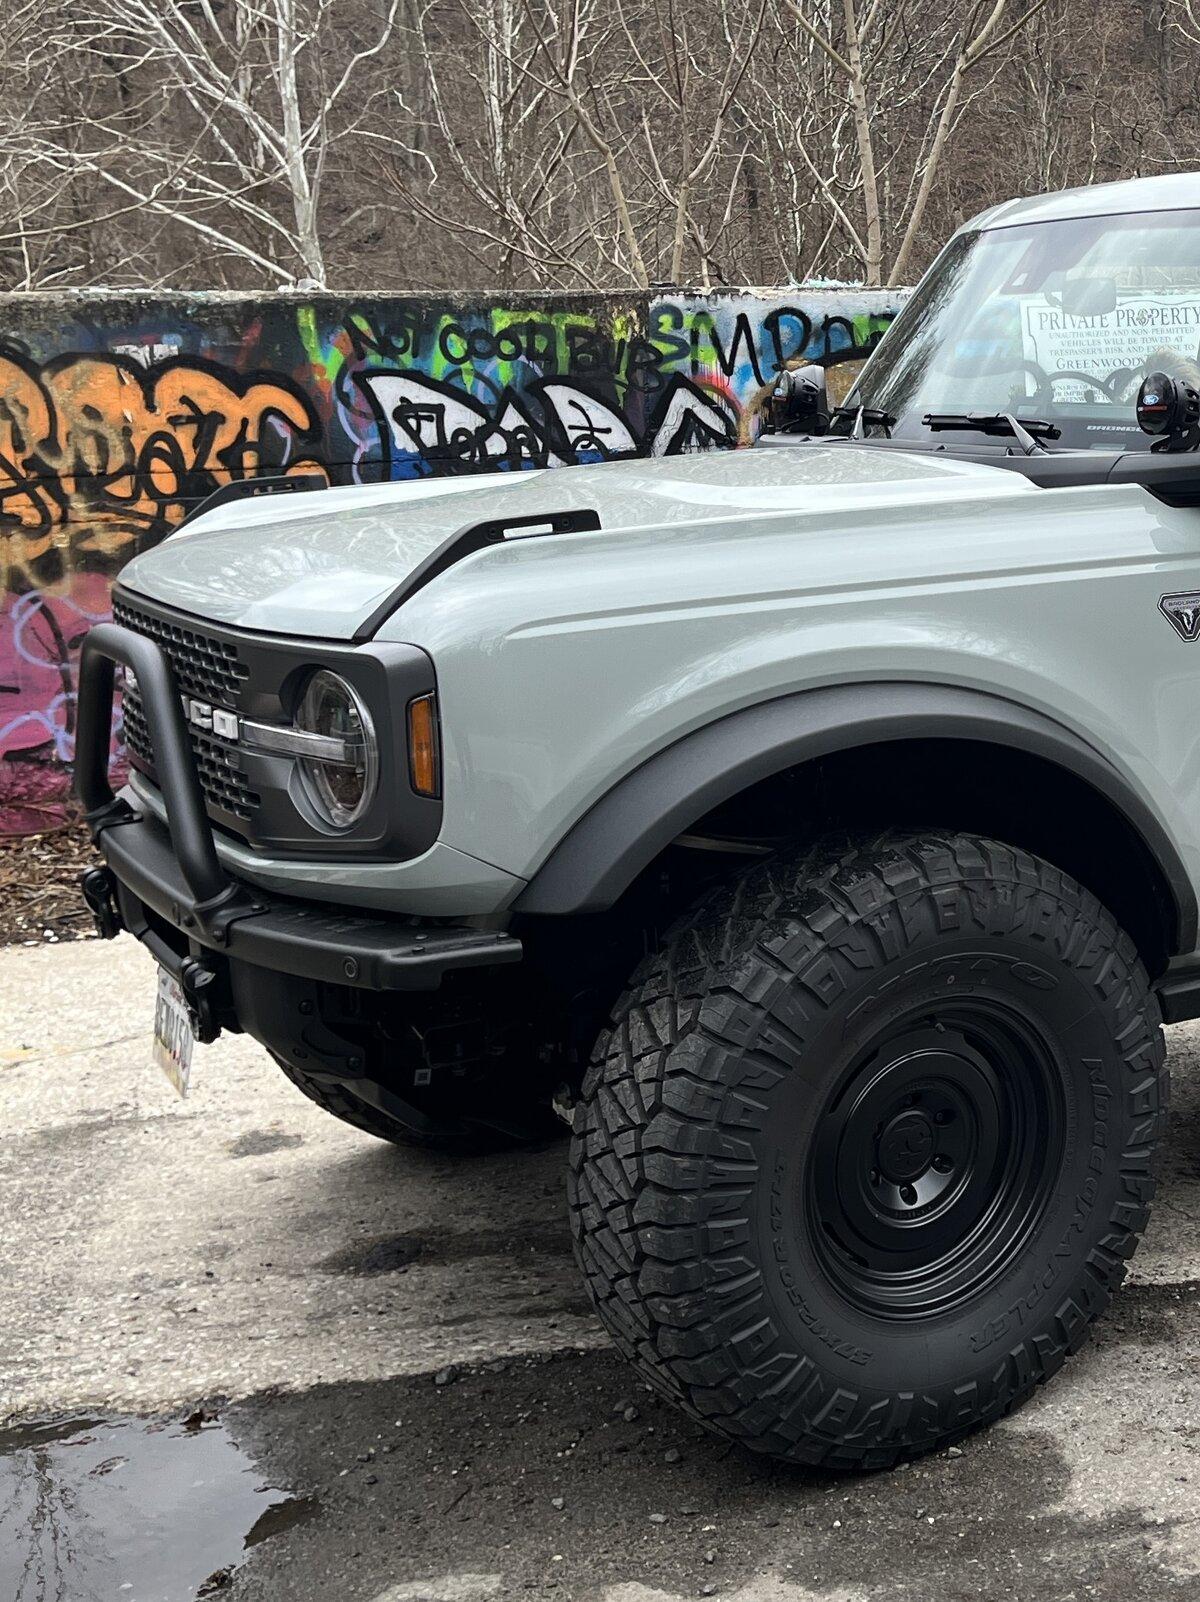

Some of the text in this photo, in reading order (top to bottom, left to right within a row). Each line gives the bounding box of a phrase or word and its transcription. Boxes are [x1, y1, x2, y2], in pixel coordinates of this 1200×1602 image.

[1038, 311, 1110, 330] PRIVATE
[1049, 330, 1110, 340] UNAUTHORIZED
[1112, 329, 1129, 337] AND
[1151, 327, 1195, 335] PERMITTED
[1060, 335, 1184, 348] VEHICLES WILL BE TOWED AT
[1105, 346, 1124, 355] RISK
[1127, 345, 1145, 354] AND
[1184, 343, 1195, 351] TO
